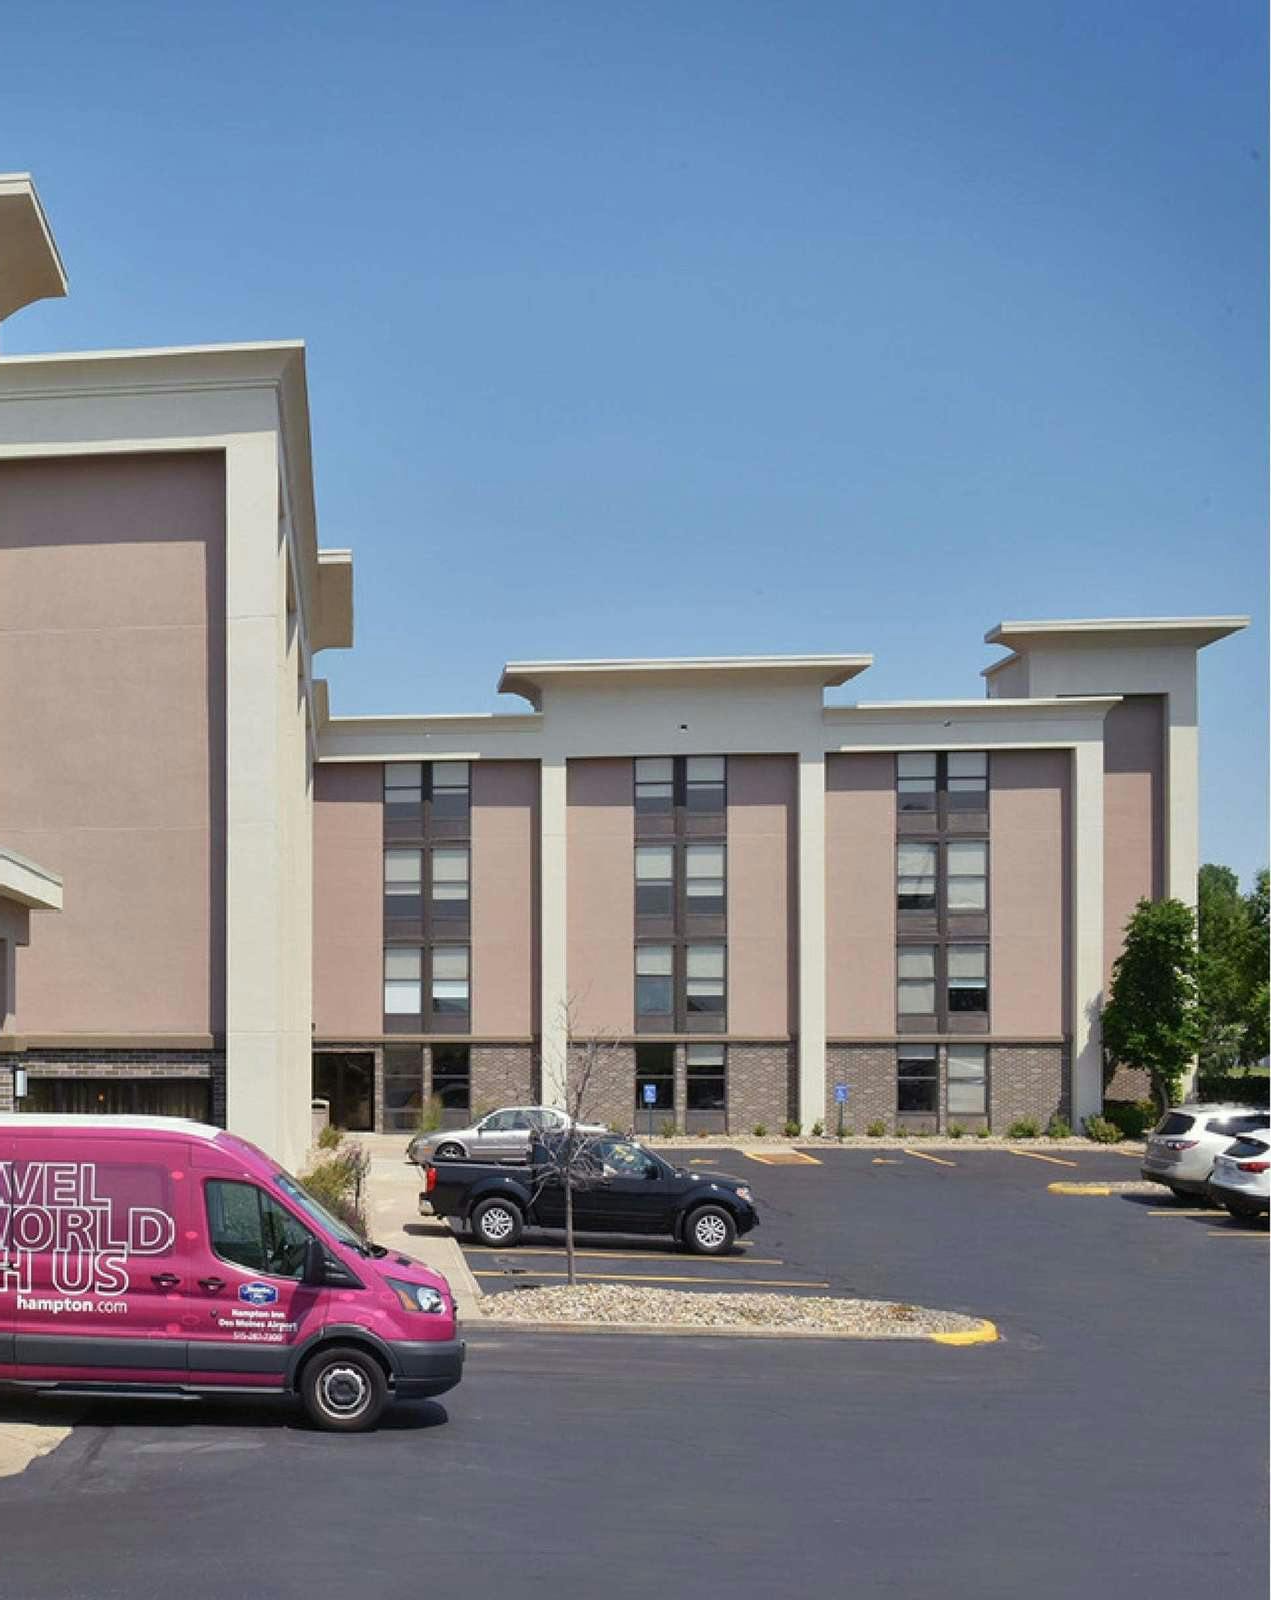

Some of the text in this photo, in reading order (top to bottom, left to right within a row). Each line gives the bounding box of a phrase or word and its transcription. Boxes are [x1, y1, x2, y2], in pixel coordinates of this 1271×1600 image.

[53, 1249, 128, 1296] US
[16, 1295, 128, 1314] hampton.com
[231, 1308, 286, 1320] Hampton Inn
[235, 1319, 265, 1328] Moines
[267, 1321, 297, 1332] Airport
